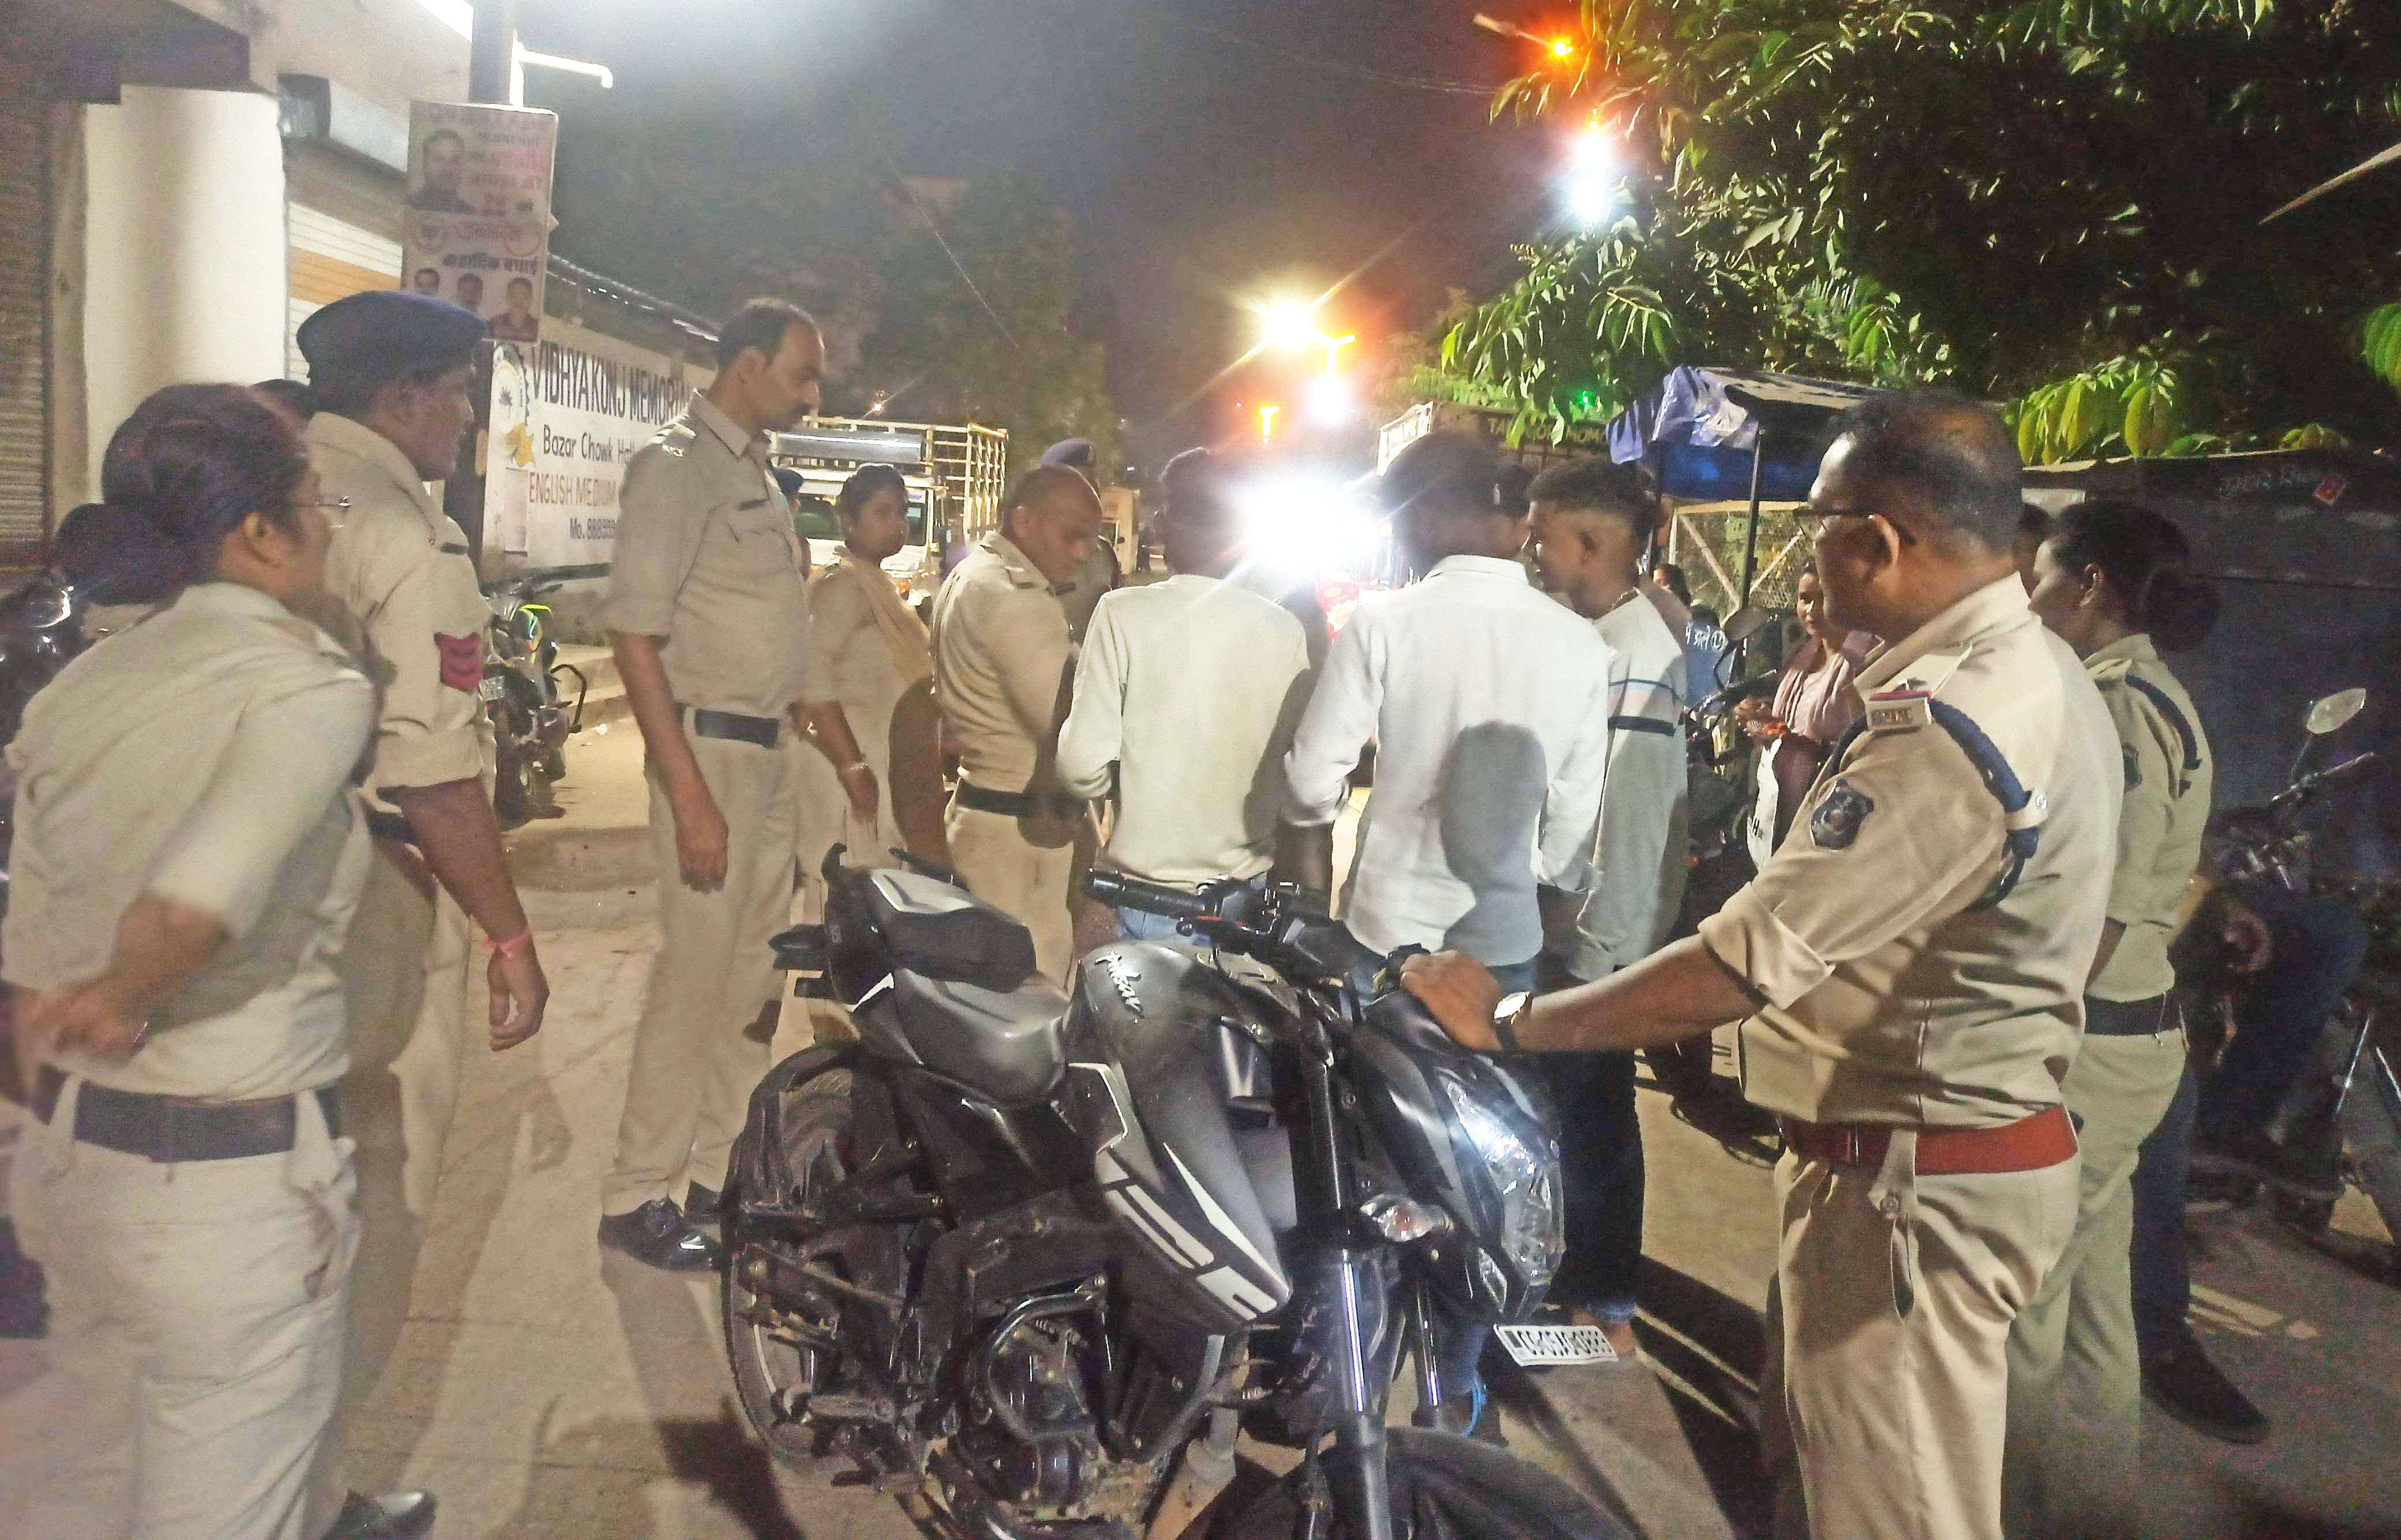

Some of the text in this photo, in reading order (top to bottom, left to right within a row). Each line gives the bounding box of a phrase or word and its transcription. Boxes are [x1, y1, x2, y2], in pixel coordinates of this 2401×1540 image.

[532, 339, 626, 418] VIDHYAKUNJ
[544, 424, 577, 458] Bazar
[582, 432, 613, 463] Chowk
[529, 472, 573, 506] ENGLISH
